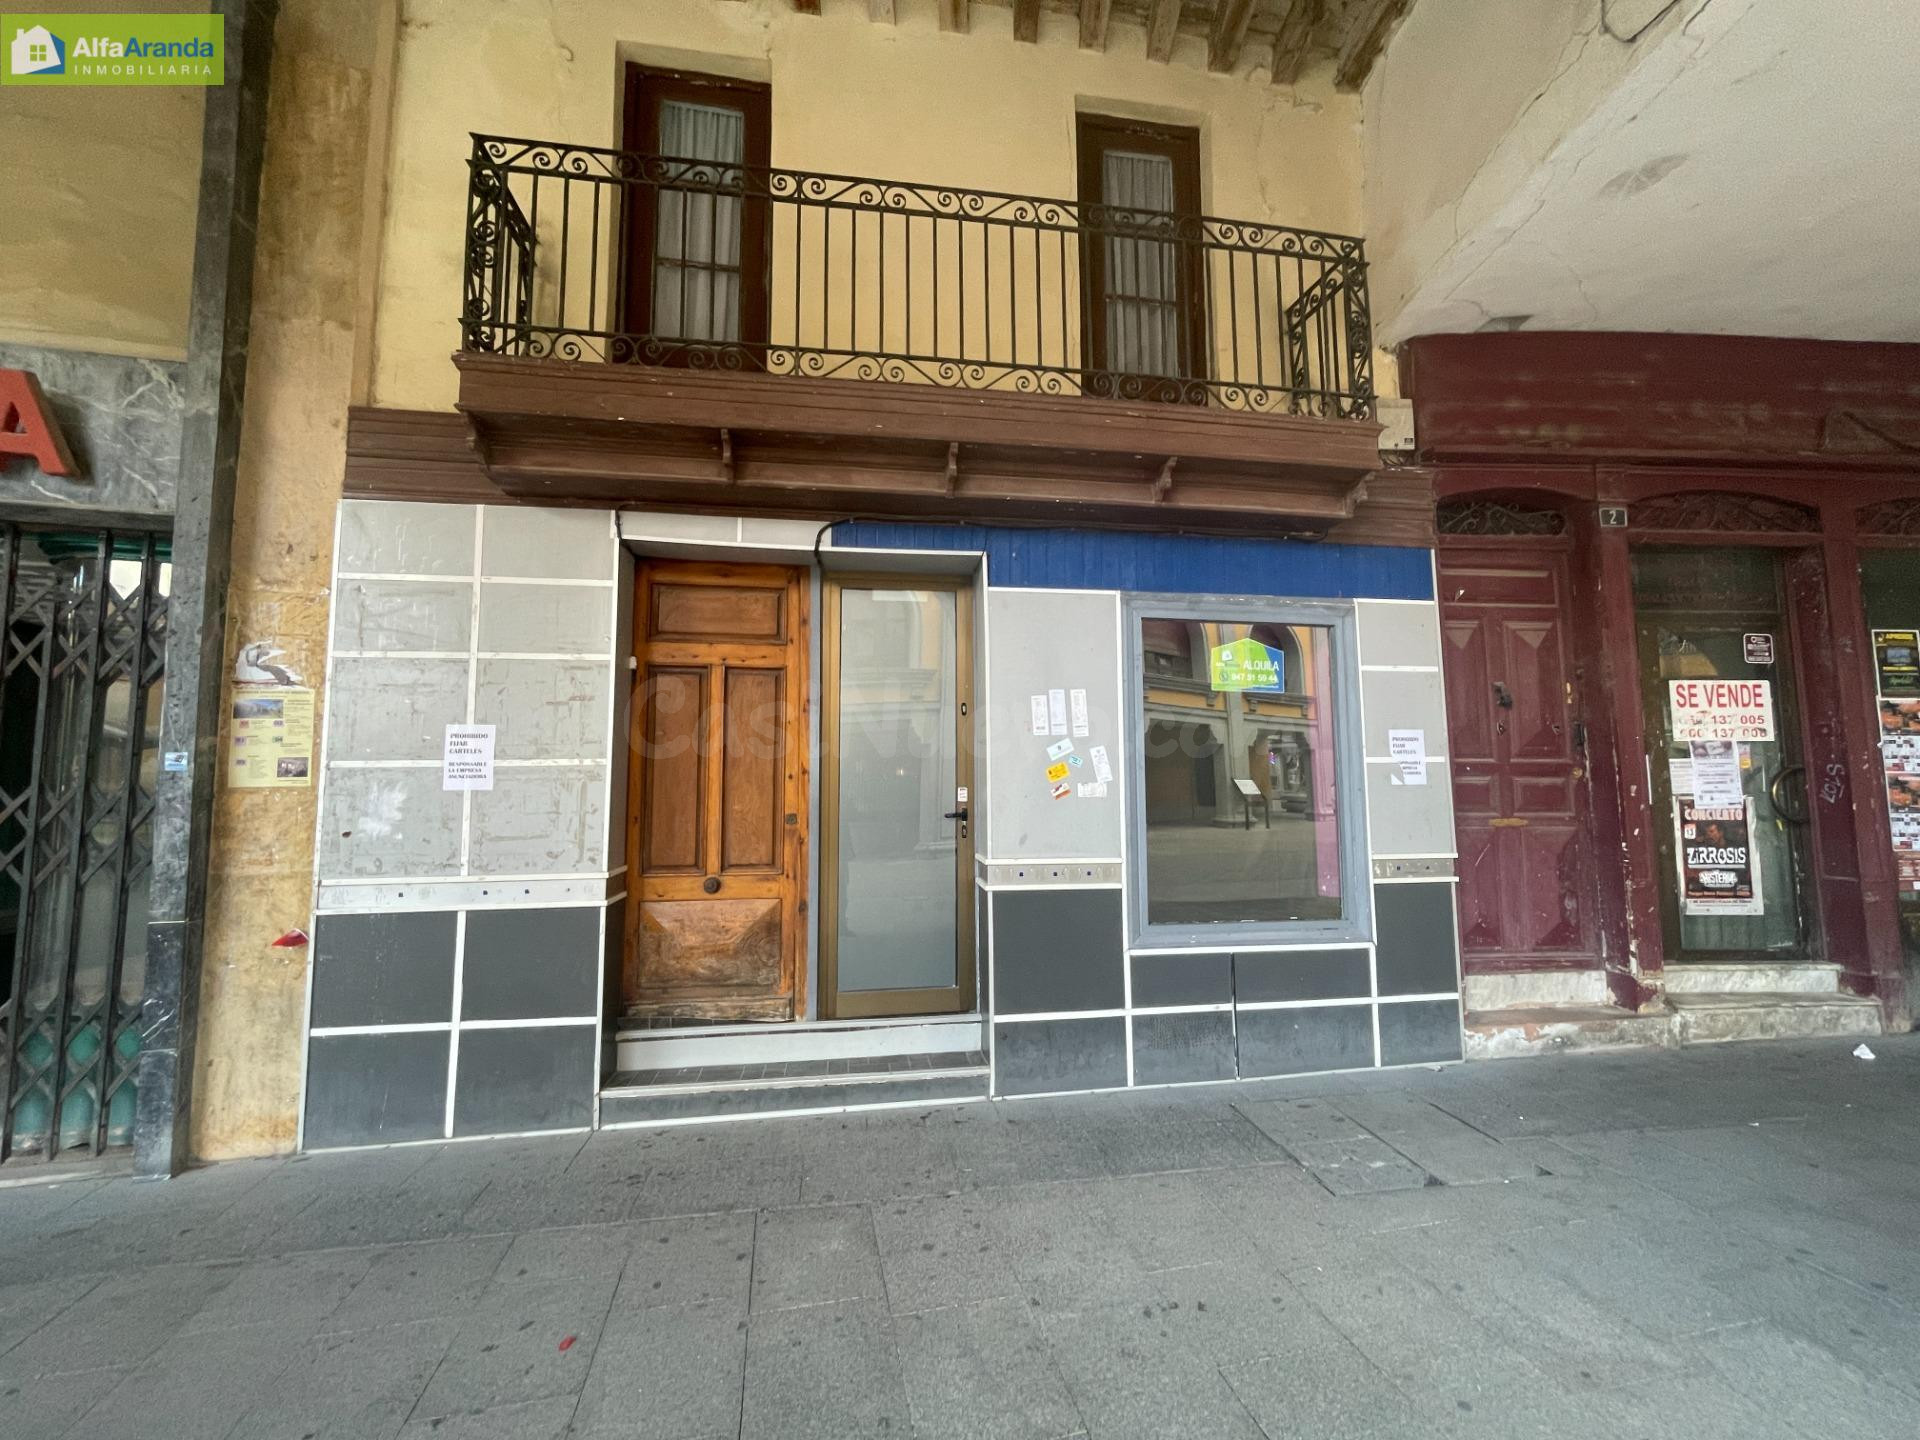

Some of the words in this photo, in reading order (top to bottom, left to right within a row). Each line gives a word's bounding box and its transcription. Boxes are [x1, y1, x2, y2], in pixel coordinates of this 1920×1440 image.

[0, 368, 76, 475] A
[1609, 510, 1617, 525] 2
[1243, 660, 1280, 671] ALQUILA
[1675, 684, 1699, 708] SE
[1703, 684, 1764, 708] VENDE
[1740, 715, 1765, 725] 005
[1712, 728, 1735, 738] 137
[1684, 808, 1743, 821] CONCIERTO
